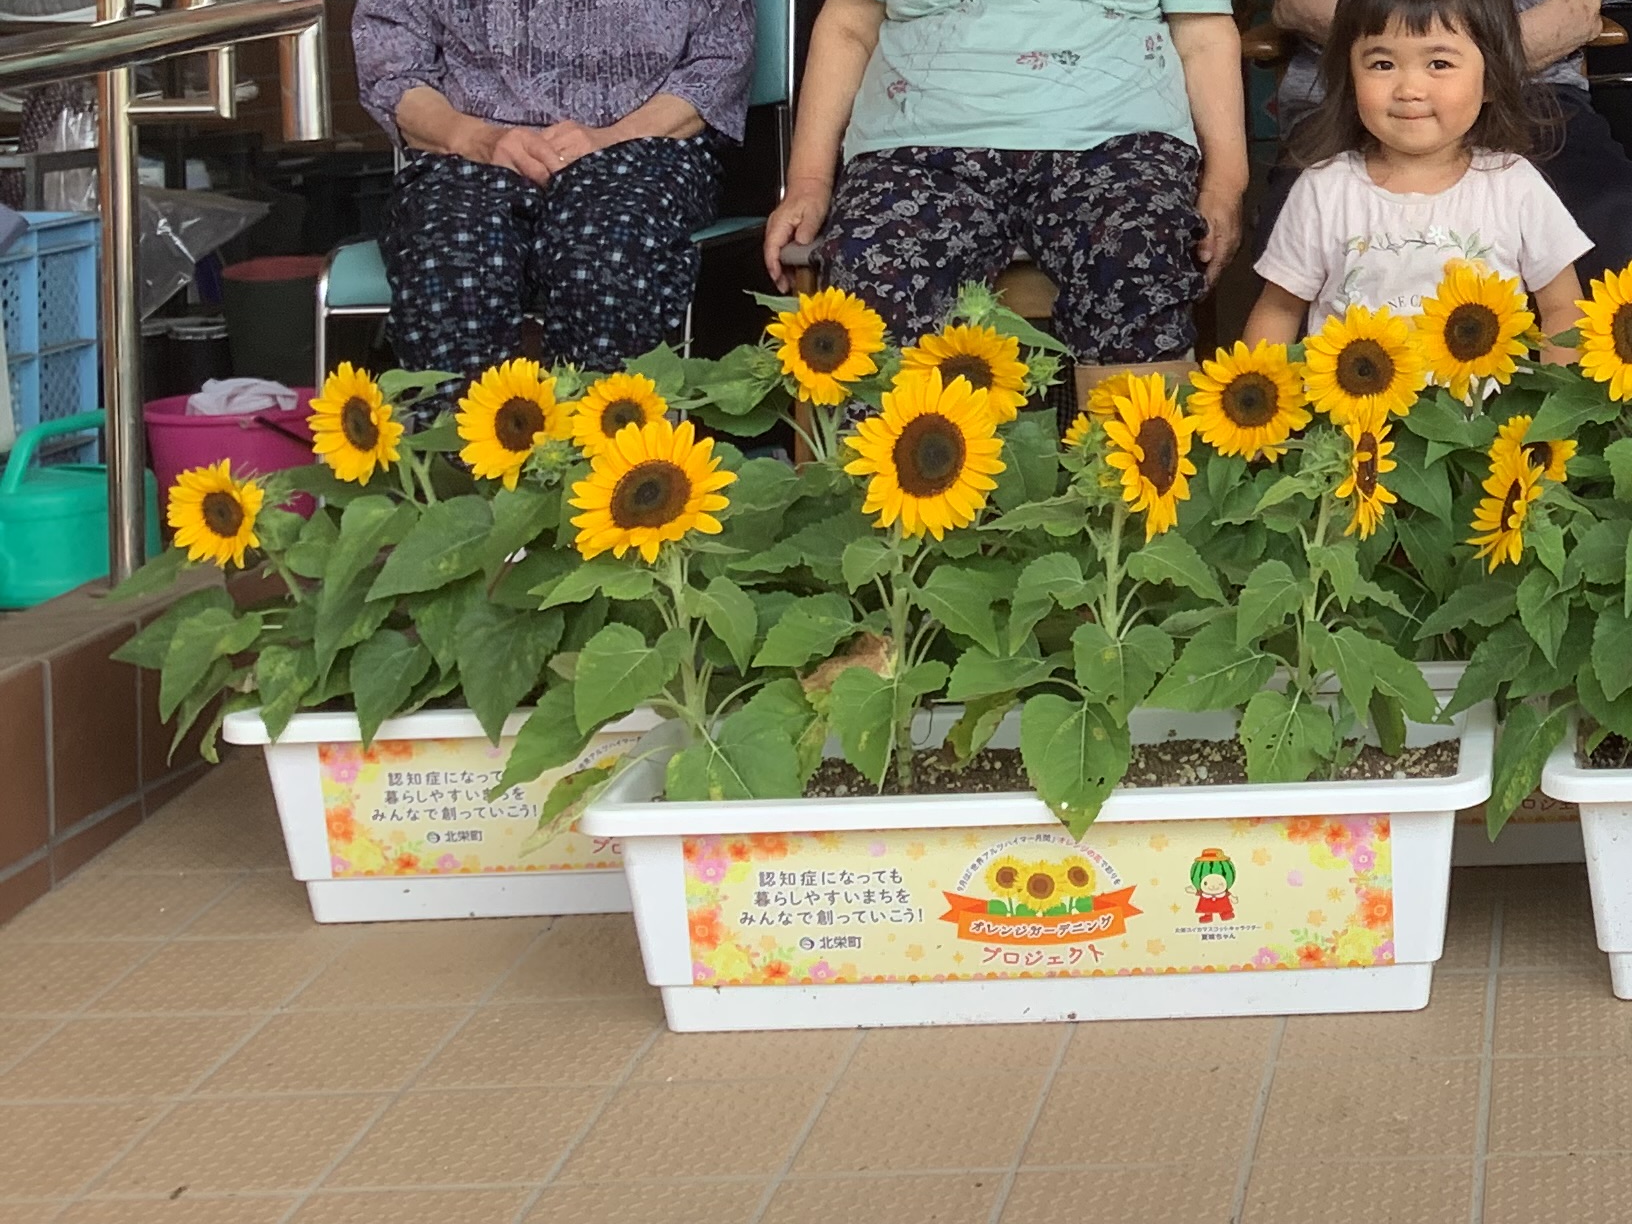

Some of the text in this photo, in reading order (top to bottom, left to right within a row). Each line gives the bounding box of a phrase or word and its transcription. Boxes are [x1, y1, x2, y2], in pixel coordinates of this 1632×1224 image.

[372, 804, 538, 822] みんなで創っていこう！
[445, 831, 483, 843] 北栄町
[759, 869, 903, 887] 認知症になっても
[754, 888, 910, 907] 暮らしやすいまちを
[740, 908, 923, 926] みんなで創っていこう！
[972, 915, 1112, 937] オレンジガーデニング
[820, 936, 862, 950] 北栄町
[982, 944, 1105, 966] プロジェクト
